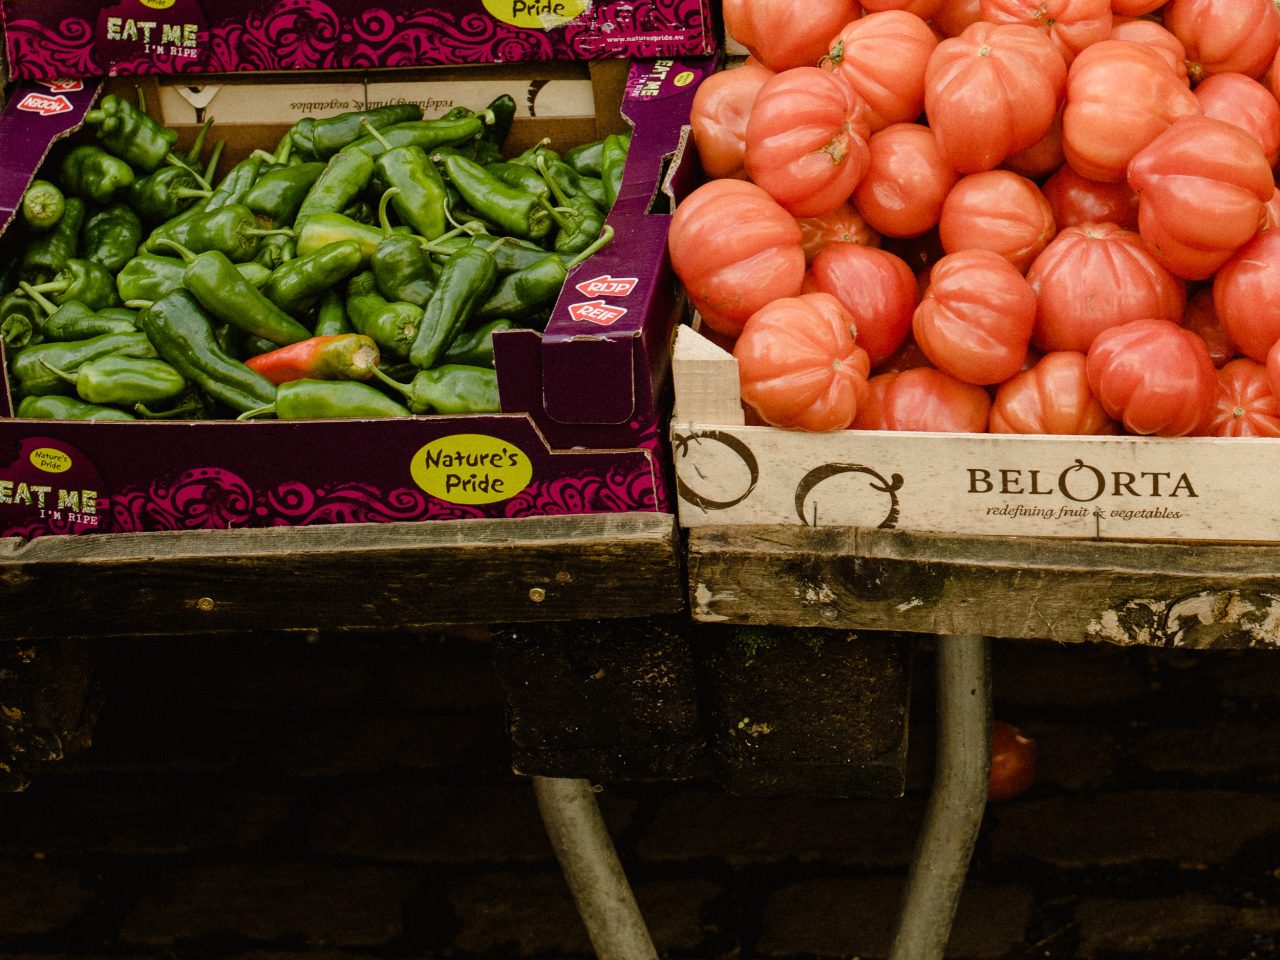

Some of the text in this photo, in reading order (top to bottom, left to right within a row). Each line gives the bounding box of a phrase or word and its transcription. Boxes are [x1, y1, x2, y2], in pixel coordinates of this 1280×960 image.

[106, 16, 199, 48] EAT ME
[606, 35, 685, 43] www.naturespride.eu
[144, 44, 198, 58] I'M RIPE
[288, 98, 350, 114] vegetables
[587, 281, 631, 294] RIJP
[577, 305, 617, 322] REIF
[34, 449, 69, 465] Nature's
[40, 459, 62, 471] Pride
[425, 447, 520, 471] Nature's
[445, 473, 505, 495] Pride
[966, 457, 1200, 503] BELORTA
[0, 480, 98, 515] EAT ME
[39, 508, 99, 526] I'M RIPE
[985, 504, 1055, 520] redefining
[1055, 505, 1090, 520] fruit
[1110, 506, 1184, 521] vegetables
